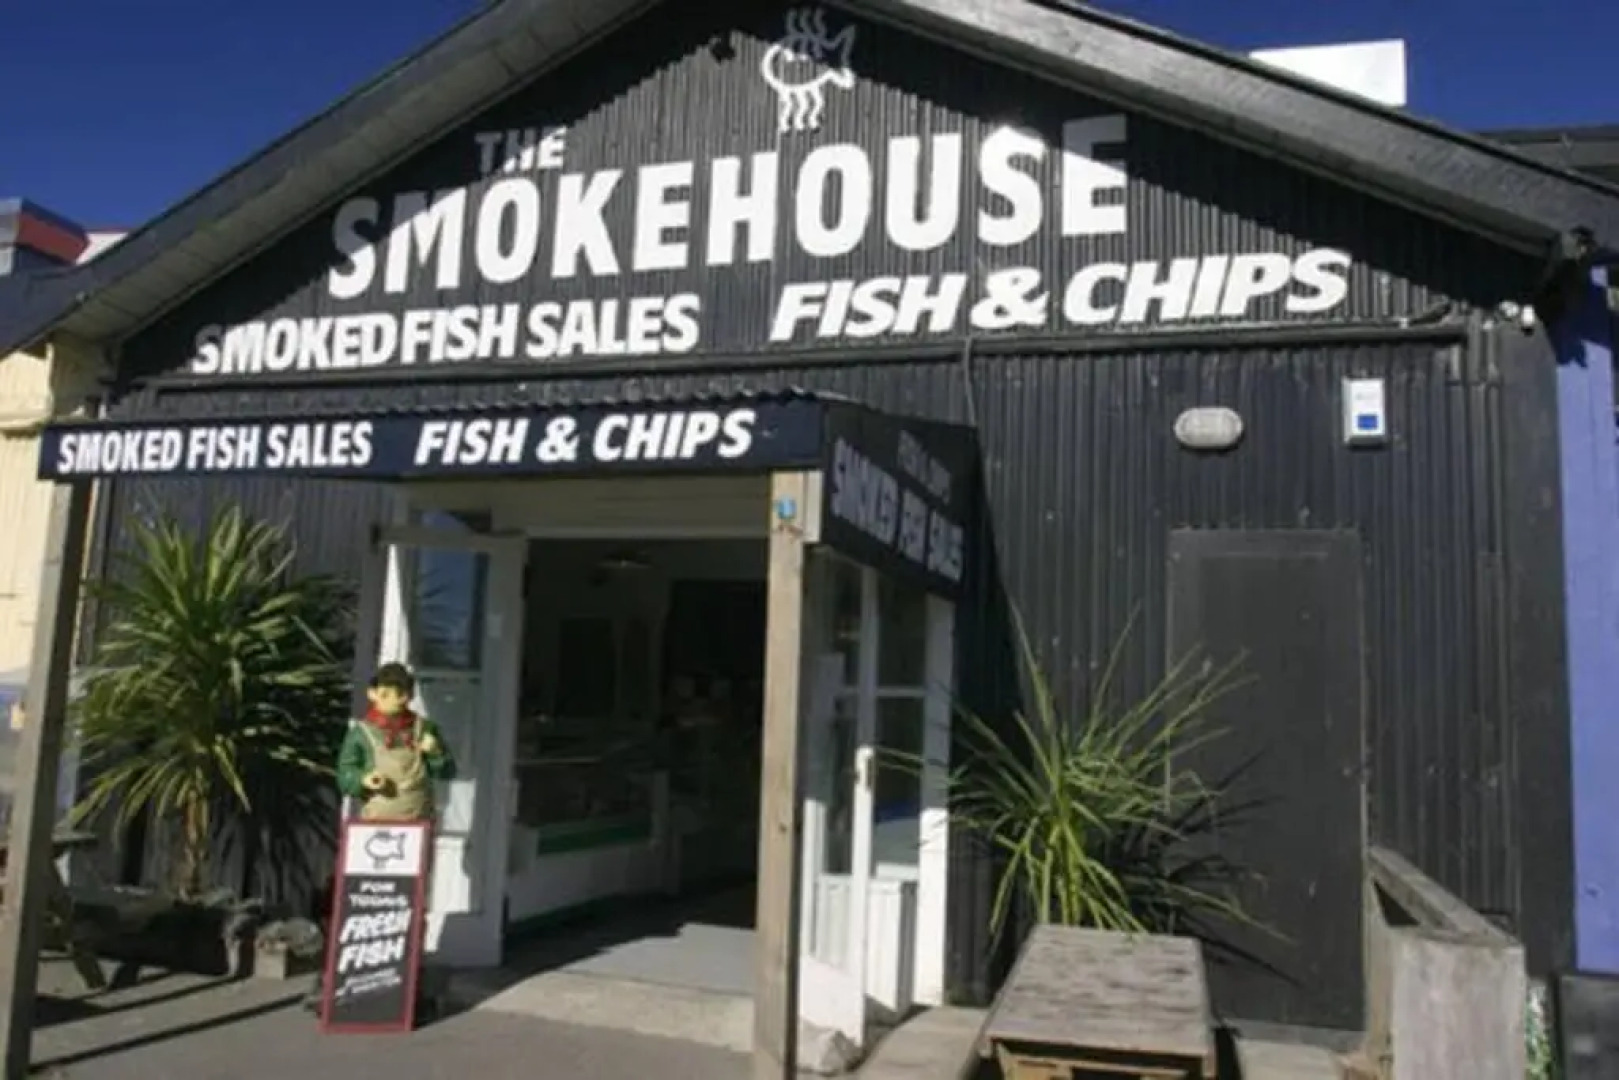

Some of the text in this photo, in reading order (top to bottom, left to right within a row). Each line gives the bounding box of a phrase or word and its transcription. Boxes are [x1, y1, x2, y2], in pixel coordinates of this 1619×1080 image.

[475, 126, 567, 173] THE
[328, 115, 1127, 299] SMOKEHOUSE
[769, 248, 1352, 341] FISH & CHIPS
[192, 293, 700, 375] SMOKED FISH SALES
[56, 420, 374, 475] SMOKED FISH SALES
[414, 408, 757, 466] FISH & CHIPS
[337, 936, 405, 974] FISH
